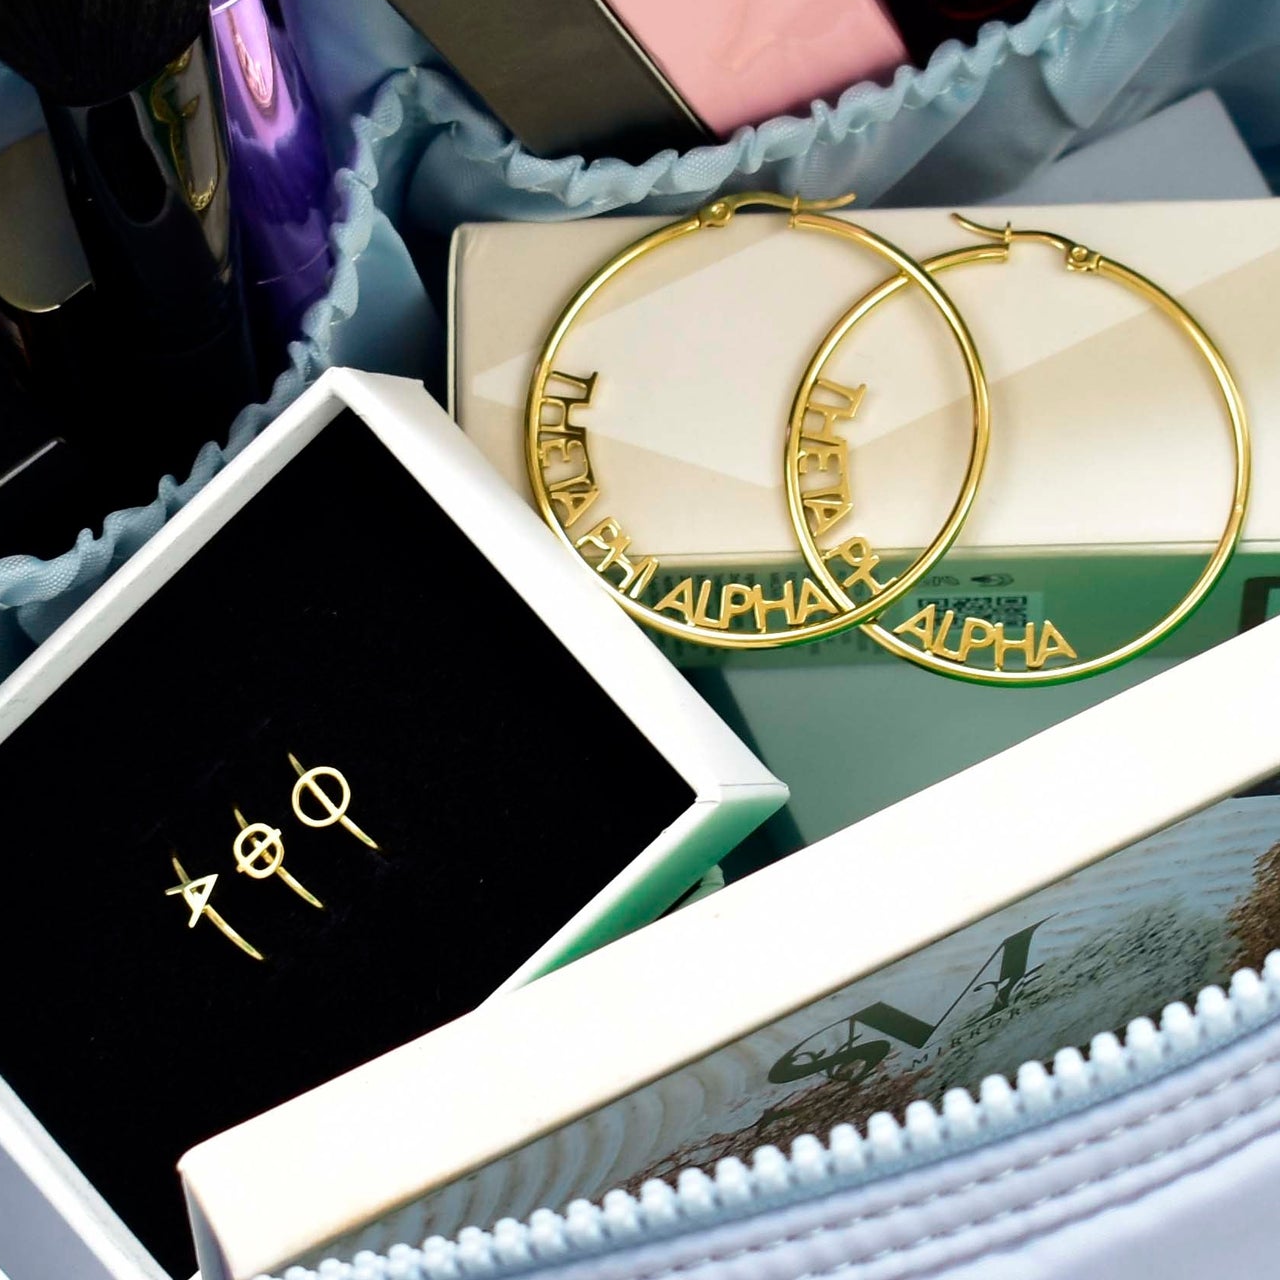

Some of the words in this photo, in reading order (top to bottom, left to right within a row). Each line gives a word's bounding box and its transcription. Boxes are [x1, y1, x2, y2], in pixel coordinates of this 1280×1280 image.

[538, 371, 600, 528] THETA
[575, 516, 660, 599] PHI
[654, 577, 840, 634] ALPHA
[798, 377, 868, 537] THETA
[820, 535, 898, 597] PH
[892, 603, 1078, 671] ALPHA
